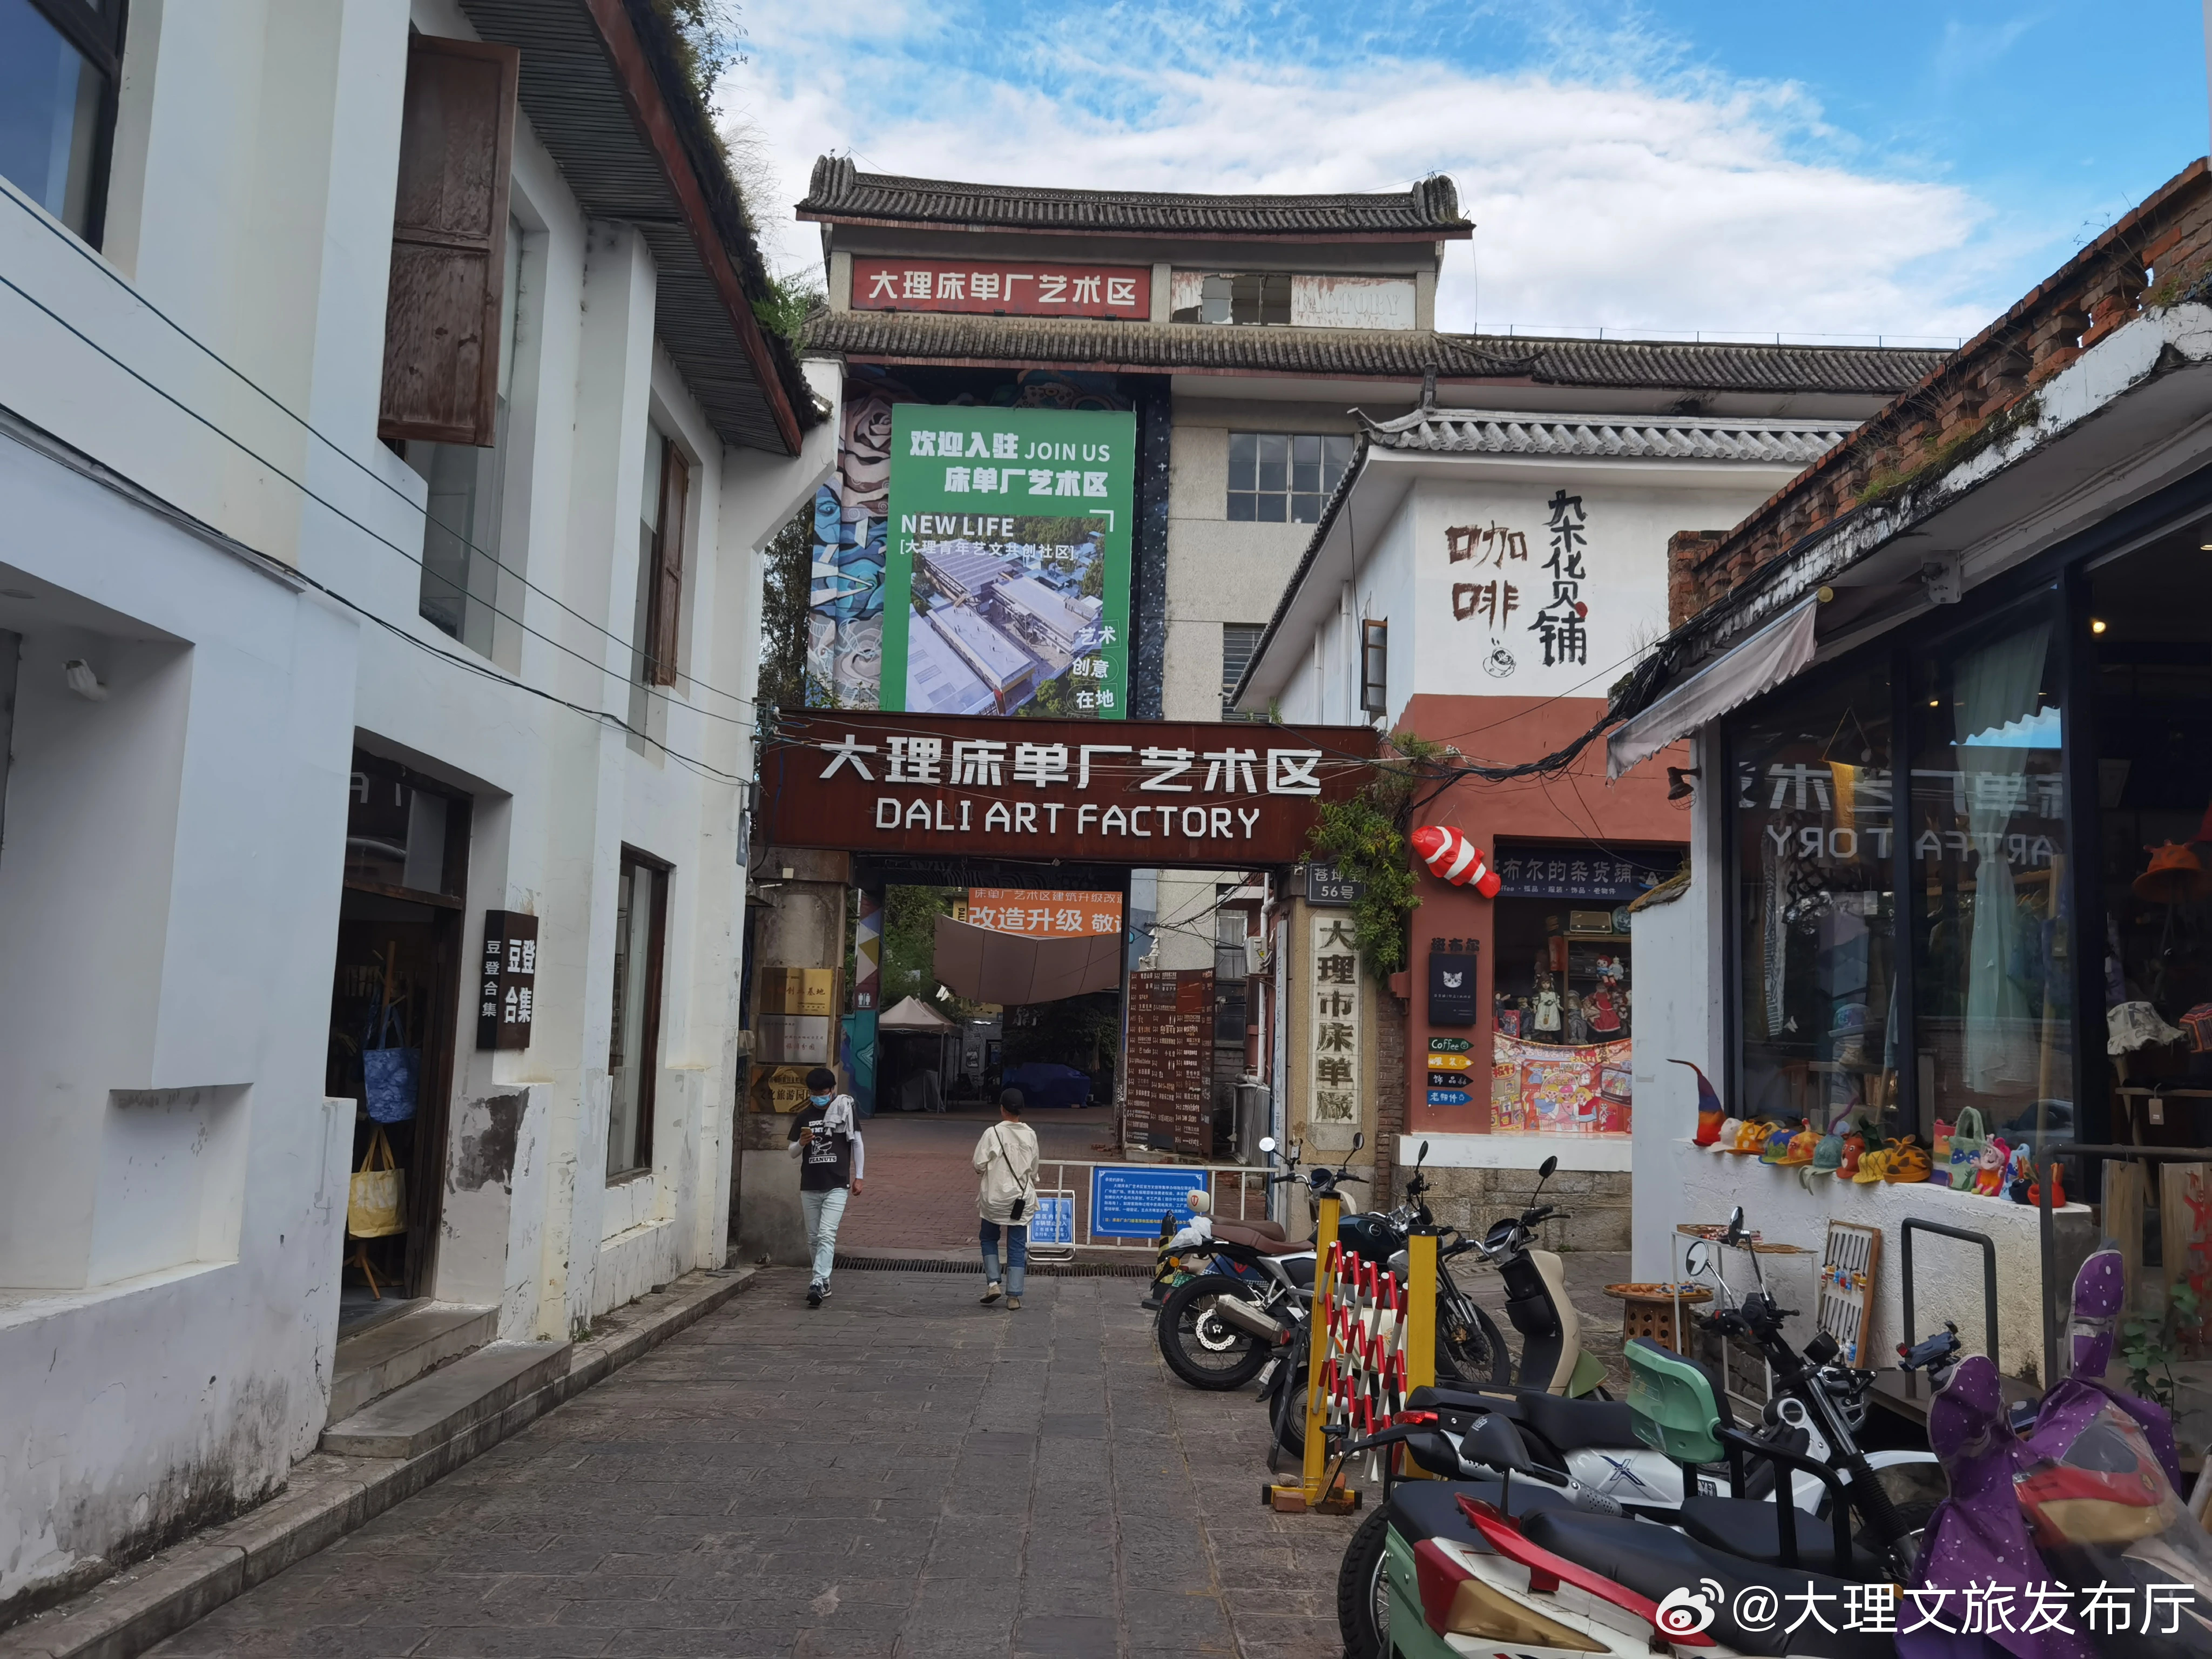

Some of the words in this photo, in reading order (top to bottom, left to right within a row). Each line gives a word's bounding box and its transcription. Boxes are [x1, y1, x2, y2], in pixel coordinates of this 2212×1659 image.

[869, 270, 1136, 306] 大理床单厂艺术区
[909, 430, 1019, 460] 欢迎入驻
[1024, 442, 1076, 461] JOIN
[1083, 444, 1110, 462] US
[944, 466, 1108, 497] 床单厂艺术区
[901, 514, 956, 536] NEW
[962, 516, 1015, 537] LIFE
[1445, 520, 1528, 633] 咖啡
[1078, 625, 1117, 646] 艺术
[1072, 657, 1109, 678] 创意
[1076, 689, 1115, 709] 在地
[819, 734, 1323, 795] 大理床单厂艺术区
[875, 798, 971, 833] DALI
[984, 801, 1064, 834] ART
[1077, 804, 1260, 840] FACTORY
[1321, 886, 1354, 899] 56号
[969, 906, 1083, 932] 改造升级
[1431, 1038, 1459, 1051] Coffee
[1433, 1074, 1456, 1085] 饰品
[1429, 1091, 1458, 1103] 老物件
